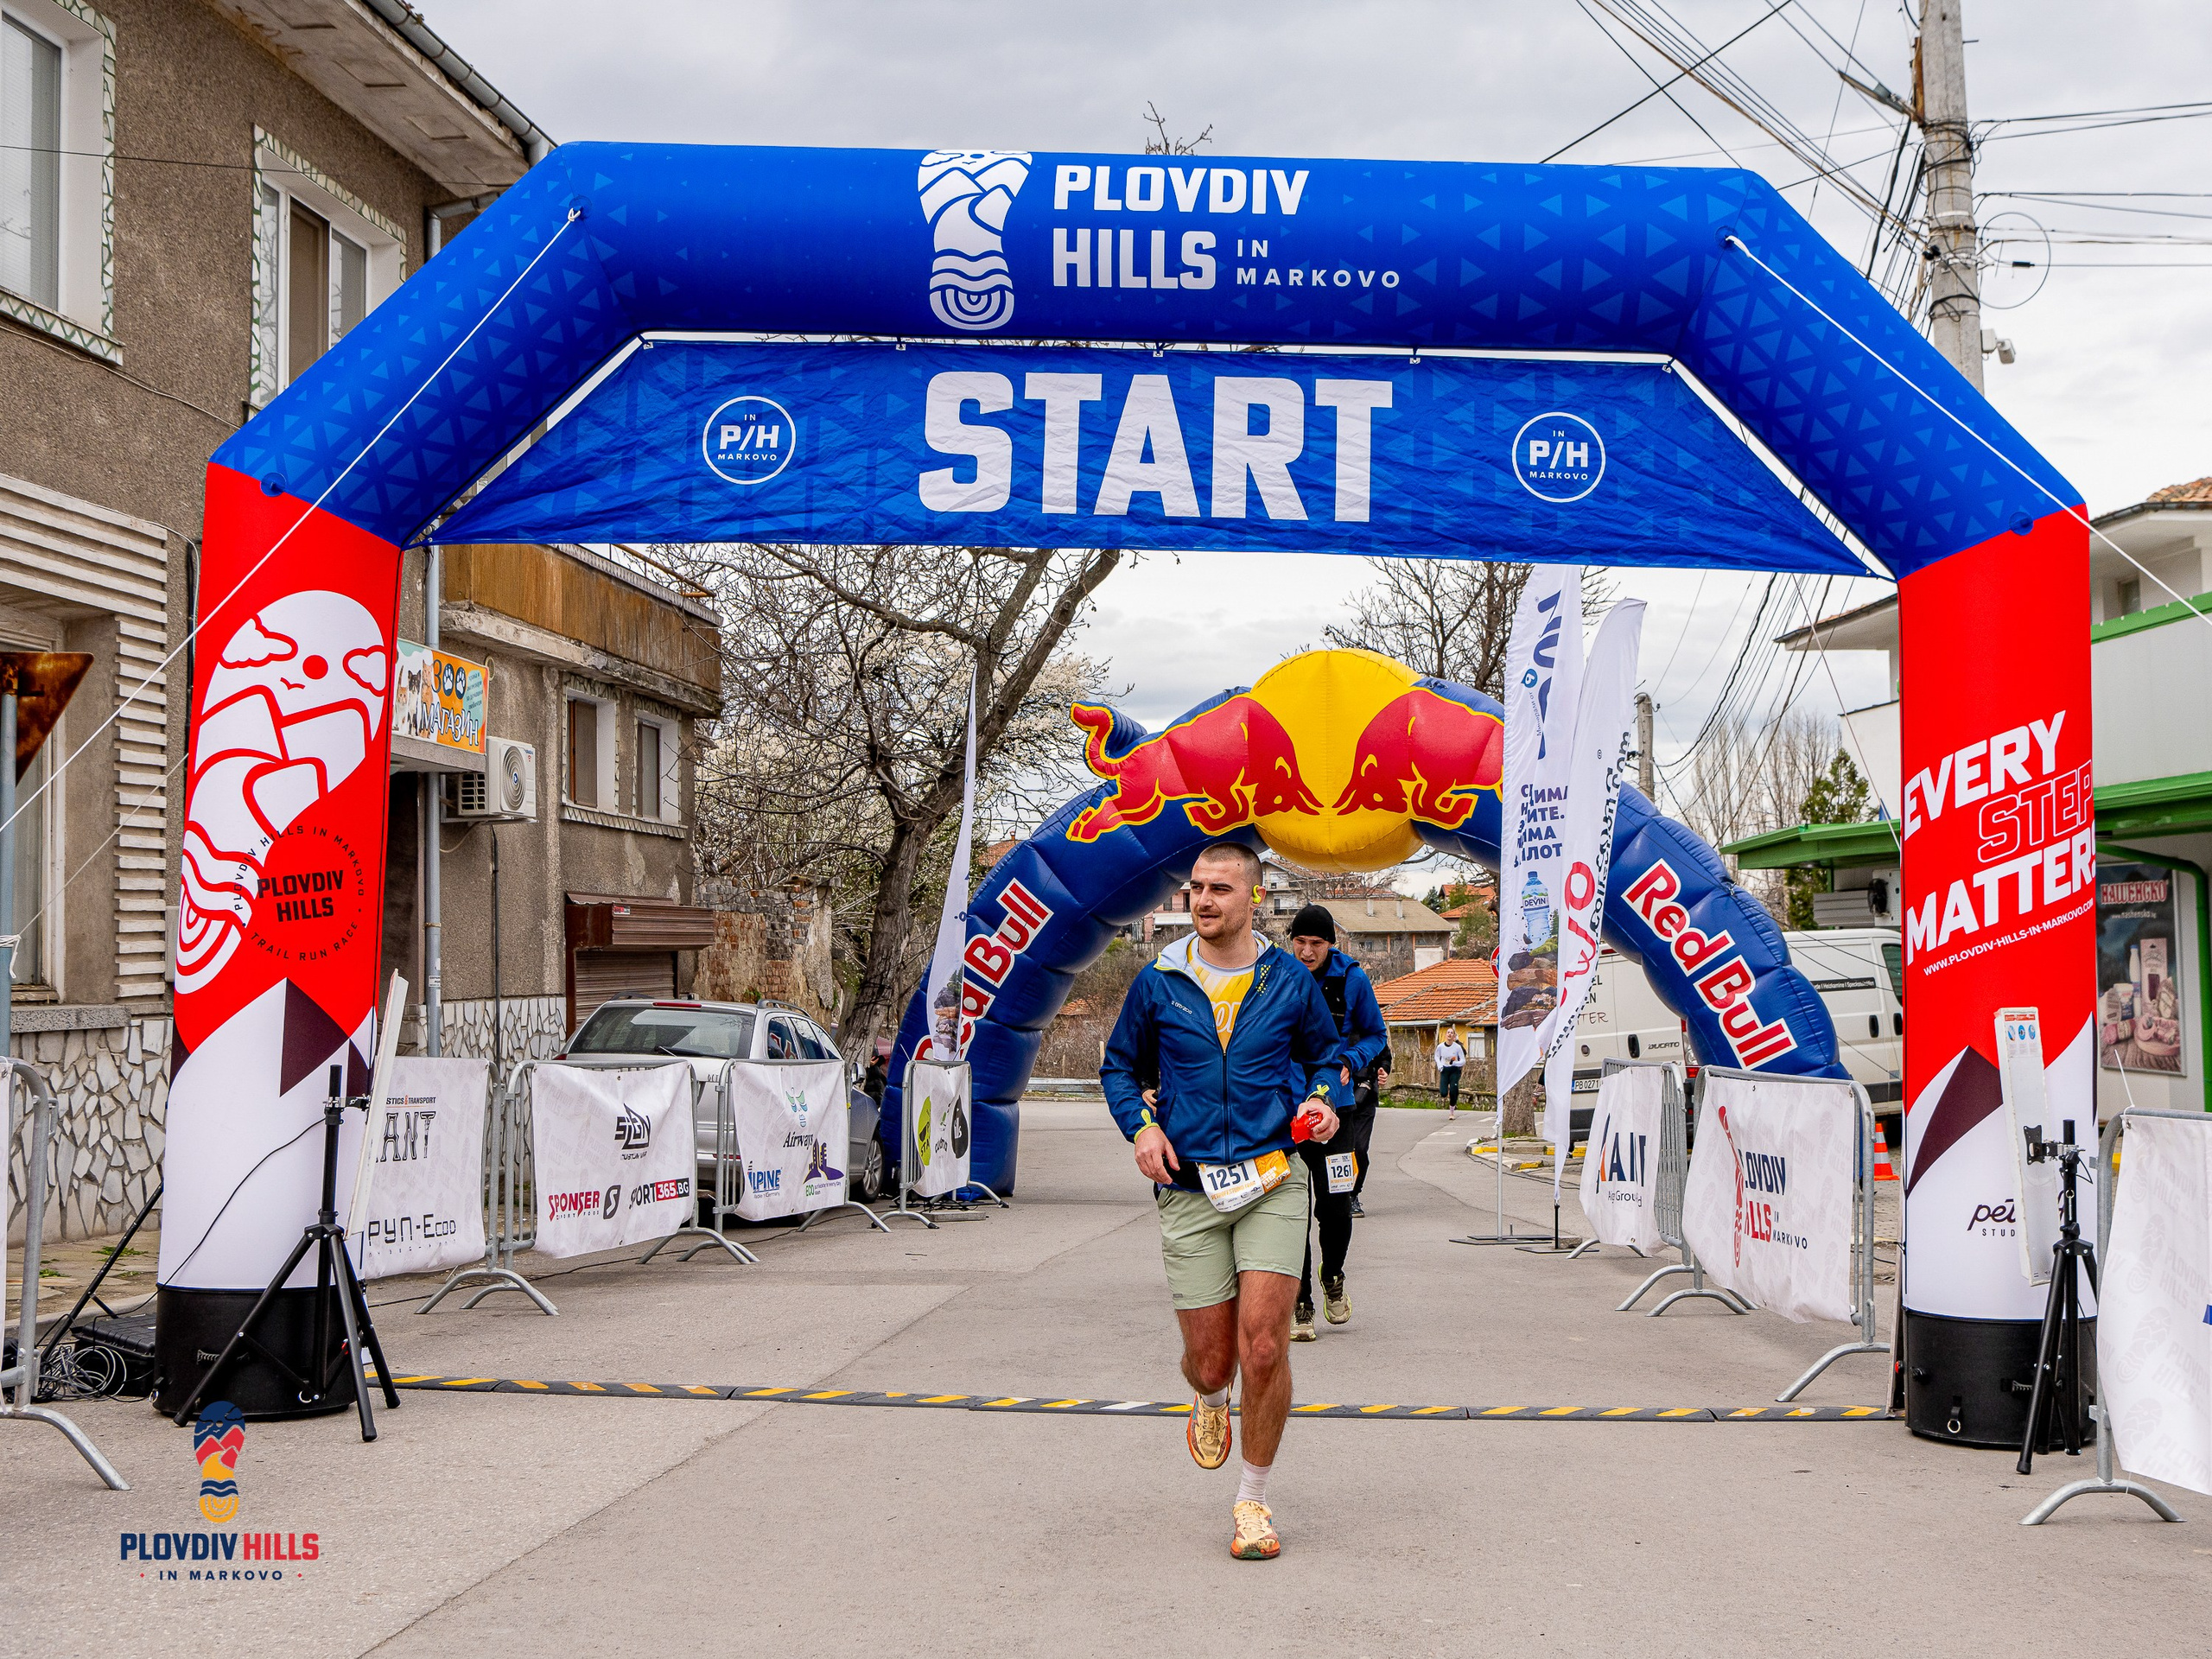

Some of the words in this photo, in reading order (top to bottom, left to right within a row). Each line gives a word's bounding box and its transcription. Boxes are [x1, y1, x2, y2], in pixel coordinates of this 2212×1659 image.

[1054, 164, 1310, 215] PLOVDIV
[1052, 228, 1217, 290] HILLS
[1237, 239, 1268, 257] IN
[1237, 267, 1401, 289] MARKOVO
[744, 413, 756, 422] IN
[719, 424, 780, 450] P/H
[918, 371, 1393, 523] START
[717, 453, 778, 462] MARKOVO
[1529, 439, 1589, 470] P/H
[1529, 471, 1589, 481] MARKOVO
[422, 702, 479, 746] МАГАЗИН
[1904, 709, 2066, 842] EVERY
[1978, 759, 2092, 863] STEP
[233, 849, 257, 912] PLOVDIV
[260, 825, 304, 847] HILLS
[313, 826, 327, 837] IN
[334, 835, 365, 896] MARKOVO
[257, 869, 344, 899] PLOVDIV
[276, 897, 334, 922] HILLS
[1524, 895, 1547, 907] DEVIN
[251, 931, 289, 960] TRAIL
[299, 950, 327, 961] RUN
[334, 921, 358, 951] RACE
[963, 877, 1054, 988] Bull
[1621, 858, 1736, 977] Red
[1693, 954, 1798, 1071] Bull
[1648, 1041, 1680, 1050] DUCATO
[1584, 1079, 1599, 1089] 0271
[376, 1110, 436, 1163] ANT
[783, 1131, 814, 1150] Airways
[1207, 1161, 1249, 1192] 1251
[1331, 1165, 1351, 1179] 1261
[1737, 1148, 1786, 1196] OVDIV
[549, 1190, 601, 1222] SPONSER
[1772, 1229, 1808, 1250] MARKVO
[1981, 1228, 2016, 1237] STUD
